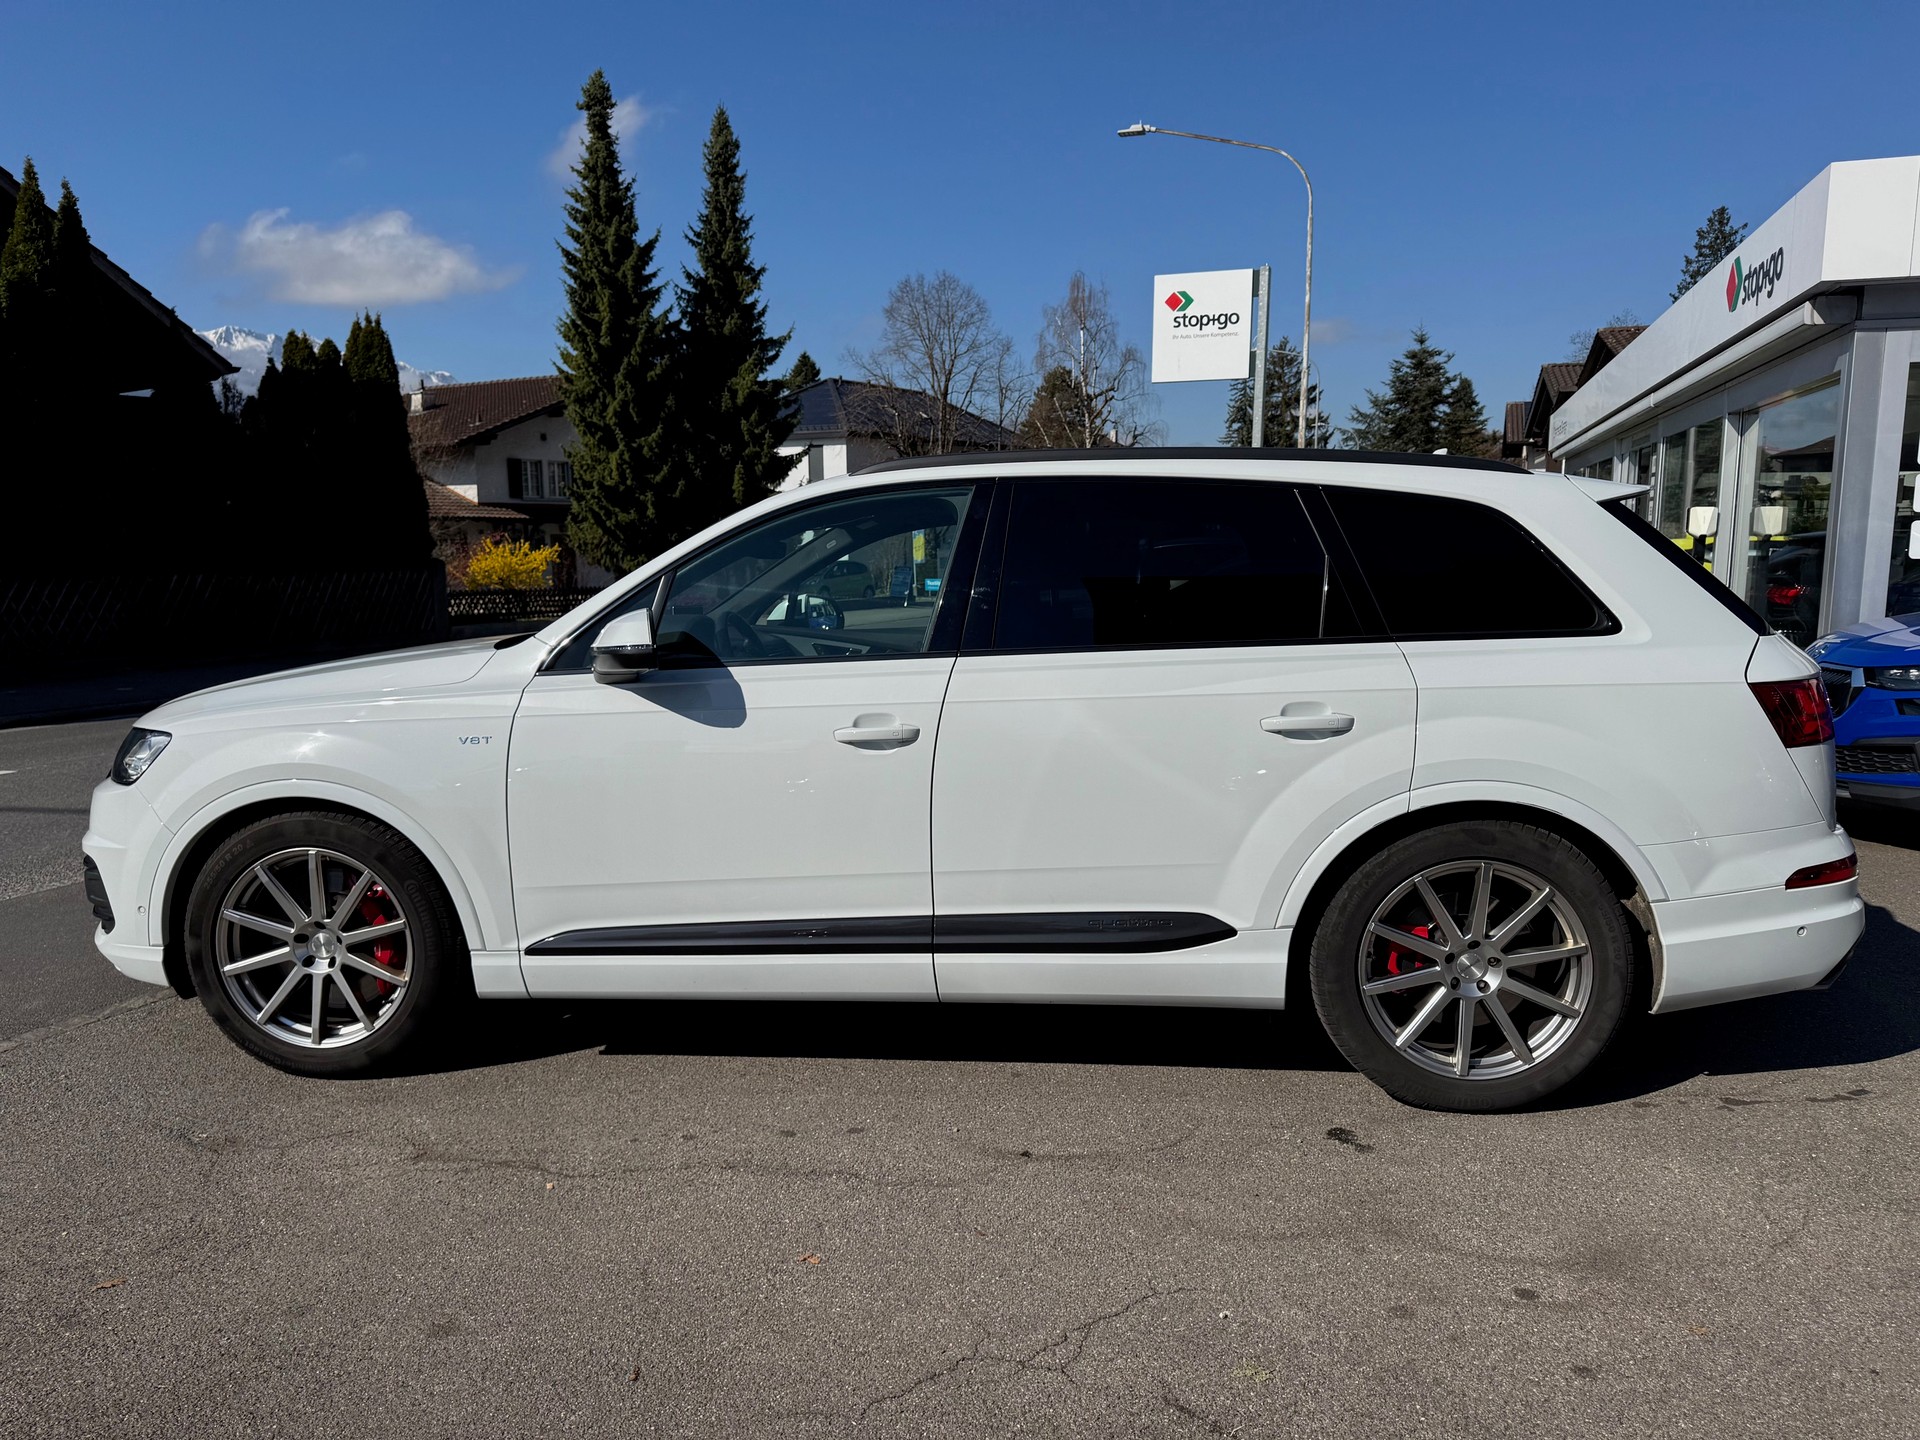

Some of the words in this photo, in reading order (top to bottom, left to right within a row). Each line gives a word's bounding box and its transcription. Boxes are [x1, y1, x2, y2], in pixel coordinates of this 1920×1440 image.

[1742, 247, 1784, 306] stop+go
[1173, 312, 1240, 331] stop+go
[458, 736, 493, 745] V8T
[231, 843, 244, 856] 20
